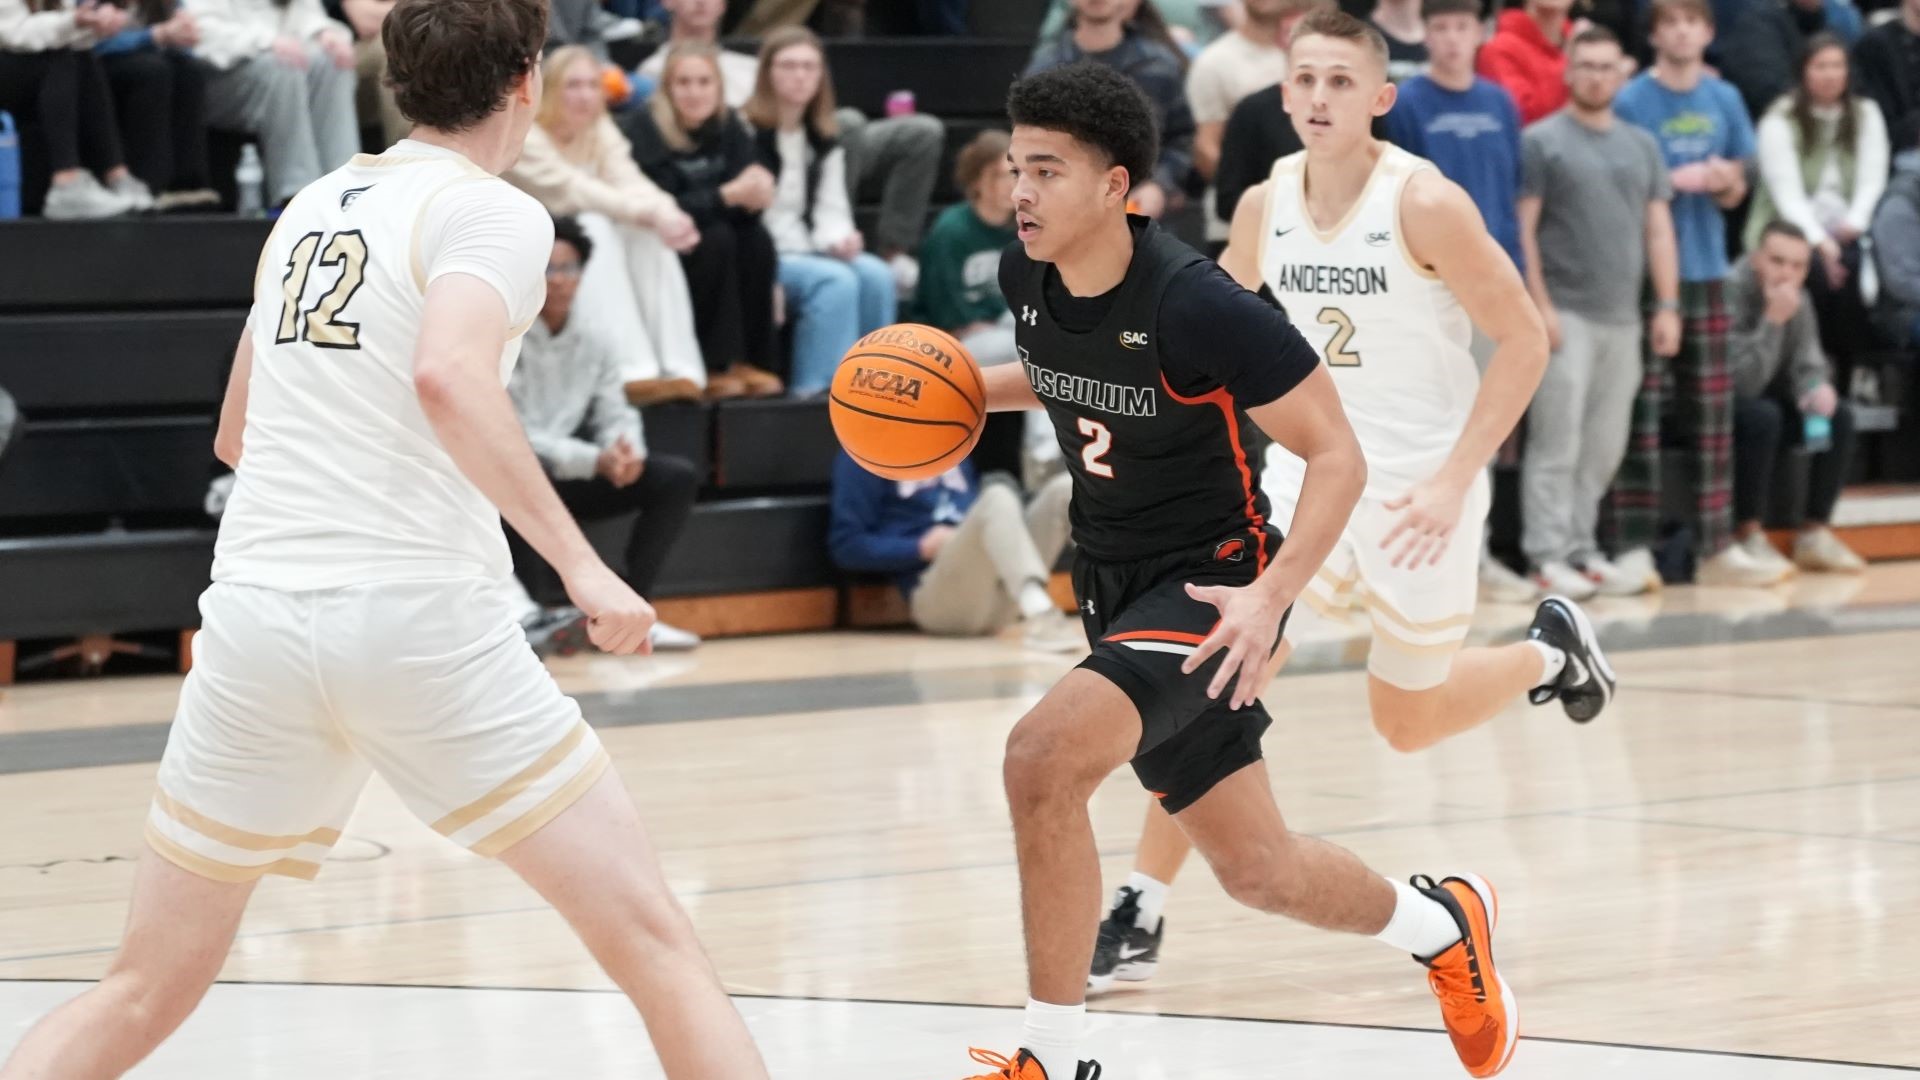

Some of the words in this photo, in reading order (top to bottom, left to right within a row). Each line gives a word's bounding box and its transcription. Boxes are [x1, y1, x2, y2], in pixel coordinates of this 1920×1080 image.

[1369, 231, 1391, 242] SAC
[275, 229, 367, 350] 12
[1279, 264, 1388, 295] ANDERSON
[1122, 331, 1148, 345] SAC
[1316, 307, 1361, 367] 2
[850, 367, 922, 401] NCAA
[1077, 416, 1115, 479] 2
